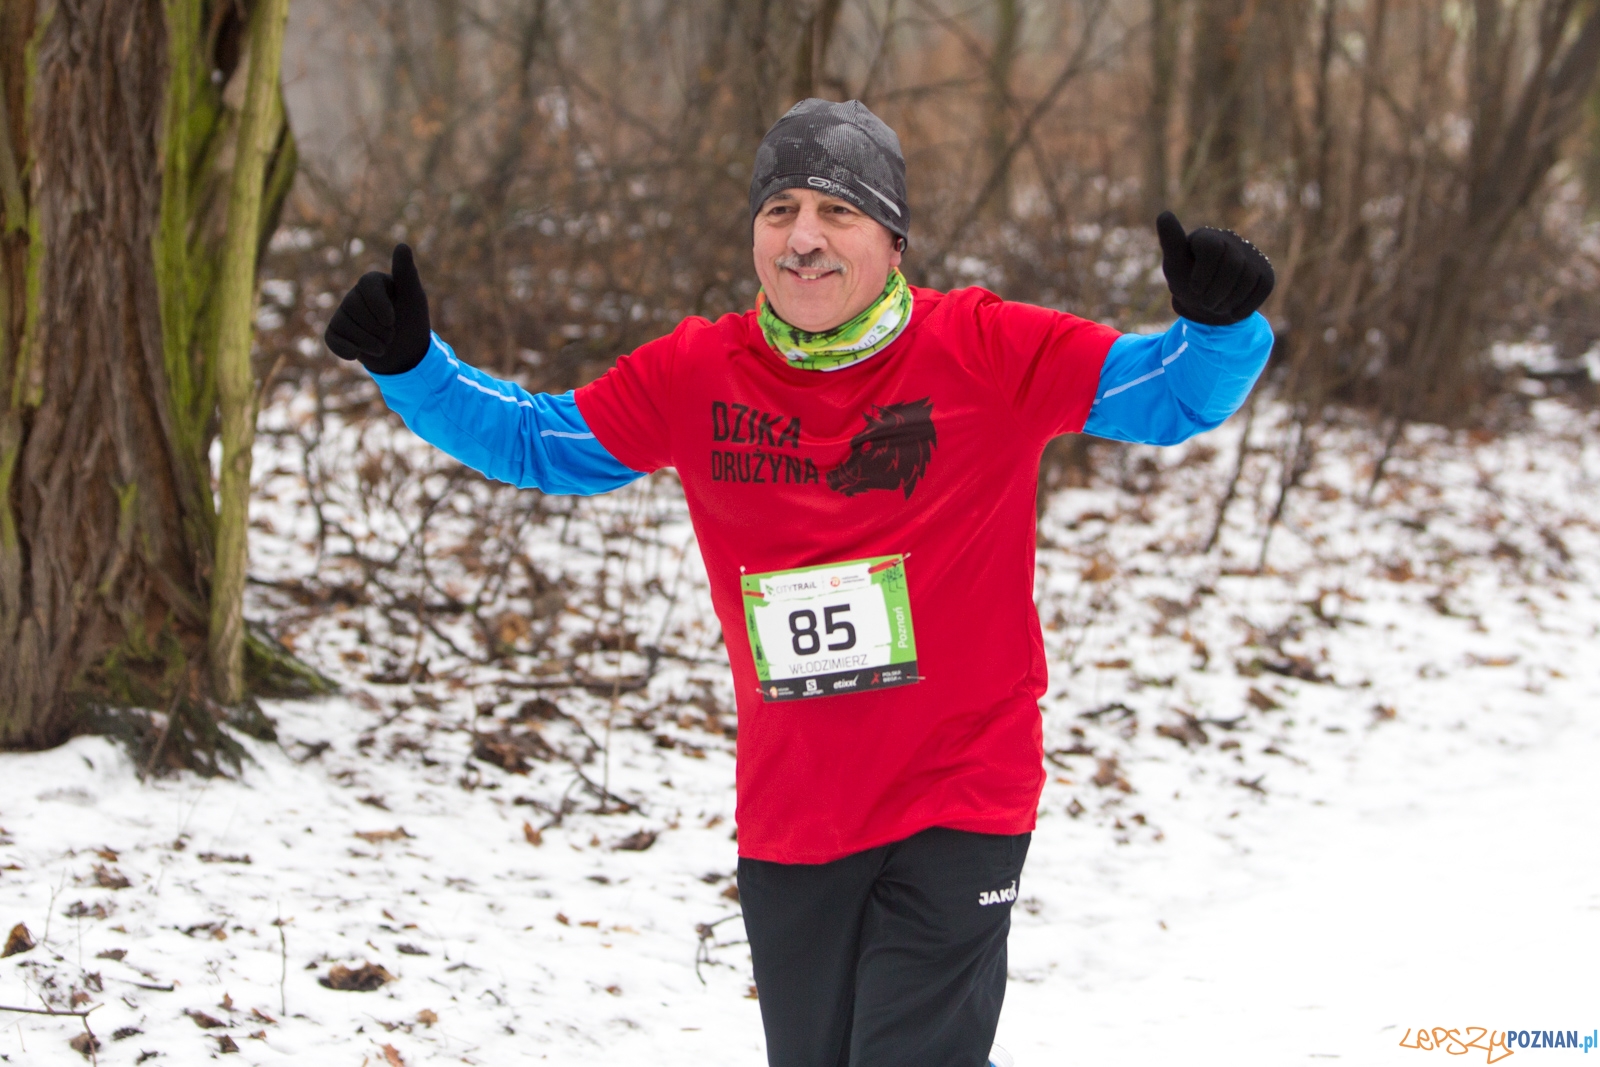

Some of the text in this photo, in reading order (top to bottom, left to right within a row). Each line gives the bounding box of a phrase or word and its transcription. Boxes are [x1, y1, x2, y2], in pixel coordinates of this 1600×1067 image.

[711, 401, 801, 448] DZIKA
[711, 449, 819, 484] DRUŻYNA
[788, 603, 857, 656] 85
[892, 606, 909, 648] Poznań
[788, 654, 868, 675] WŁODZIMIERZ
